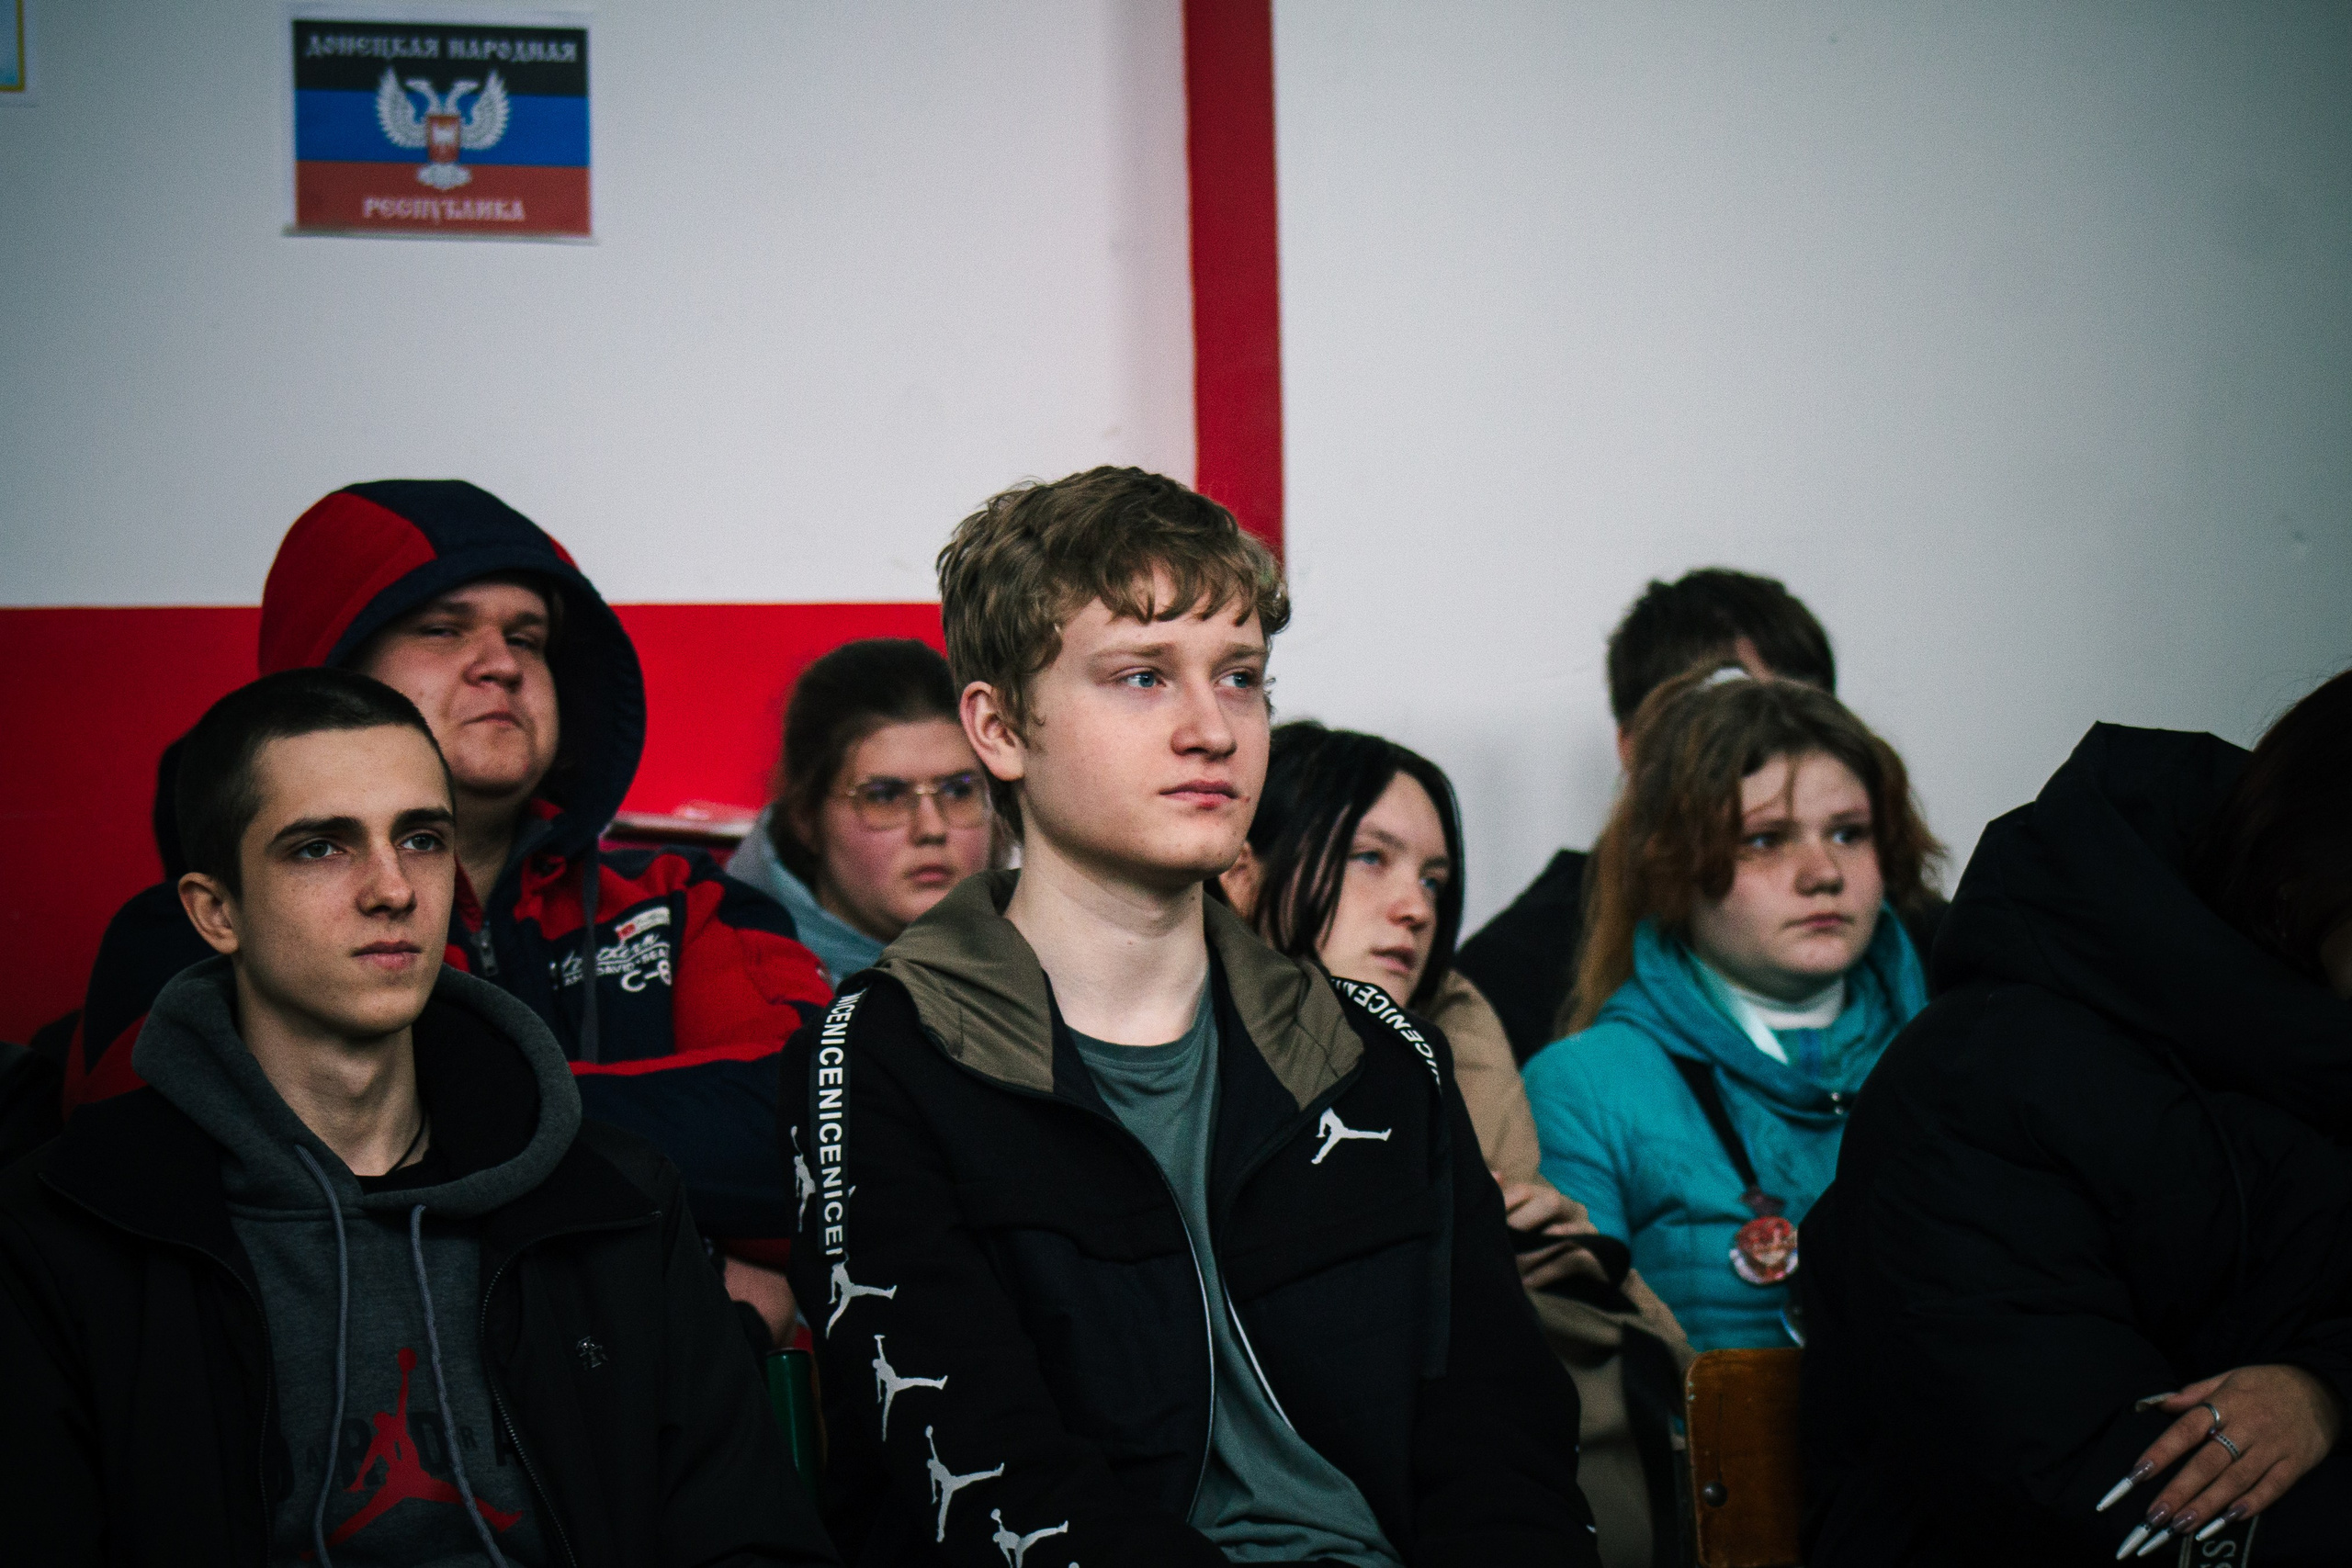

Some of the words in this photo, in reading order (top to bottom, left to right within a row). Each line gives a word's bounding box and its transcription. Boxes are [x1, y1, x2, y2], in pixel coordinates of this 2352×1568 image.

[306, 33, 439, 59] ДОНЕЦКАЯ
[447, 38, 577, 62] НАРОДНАЯ
[363, 197, 526, 224] РЕСПУБЛИКА
